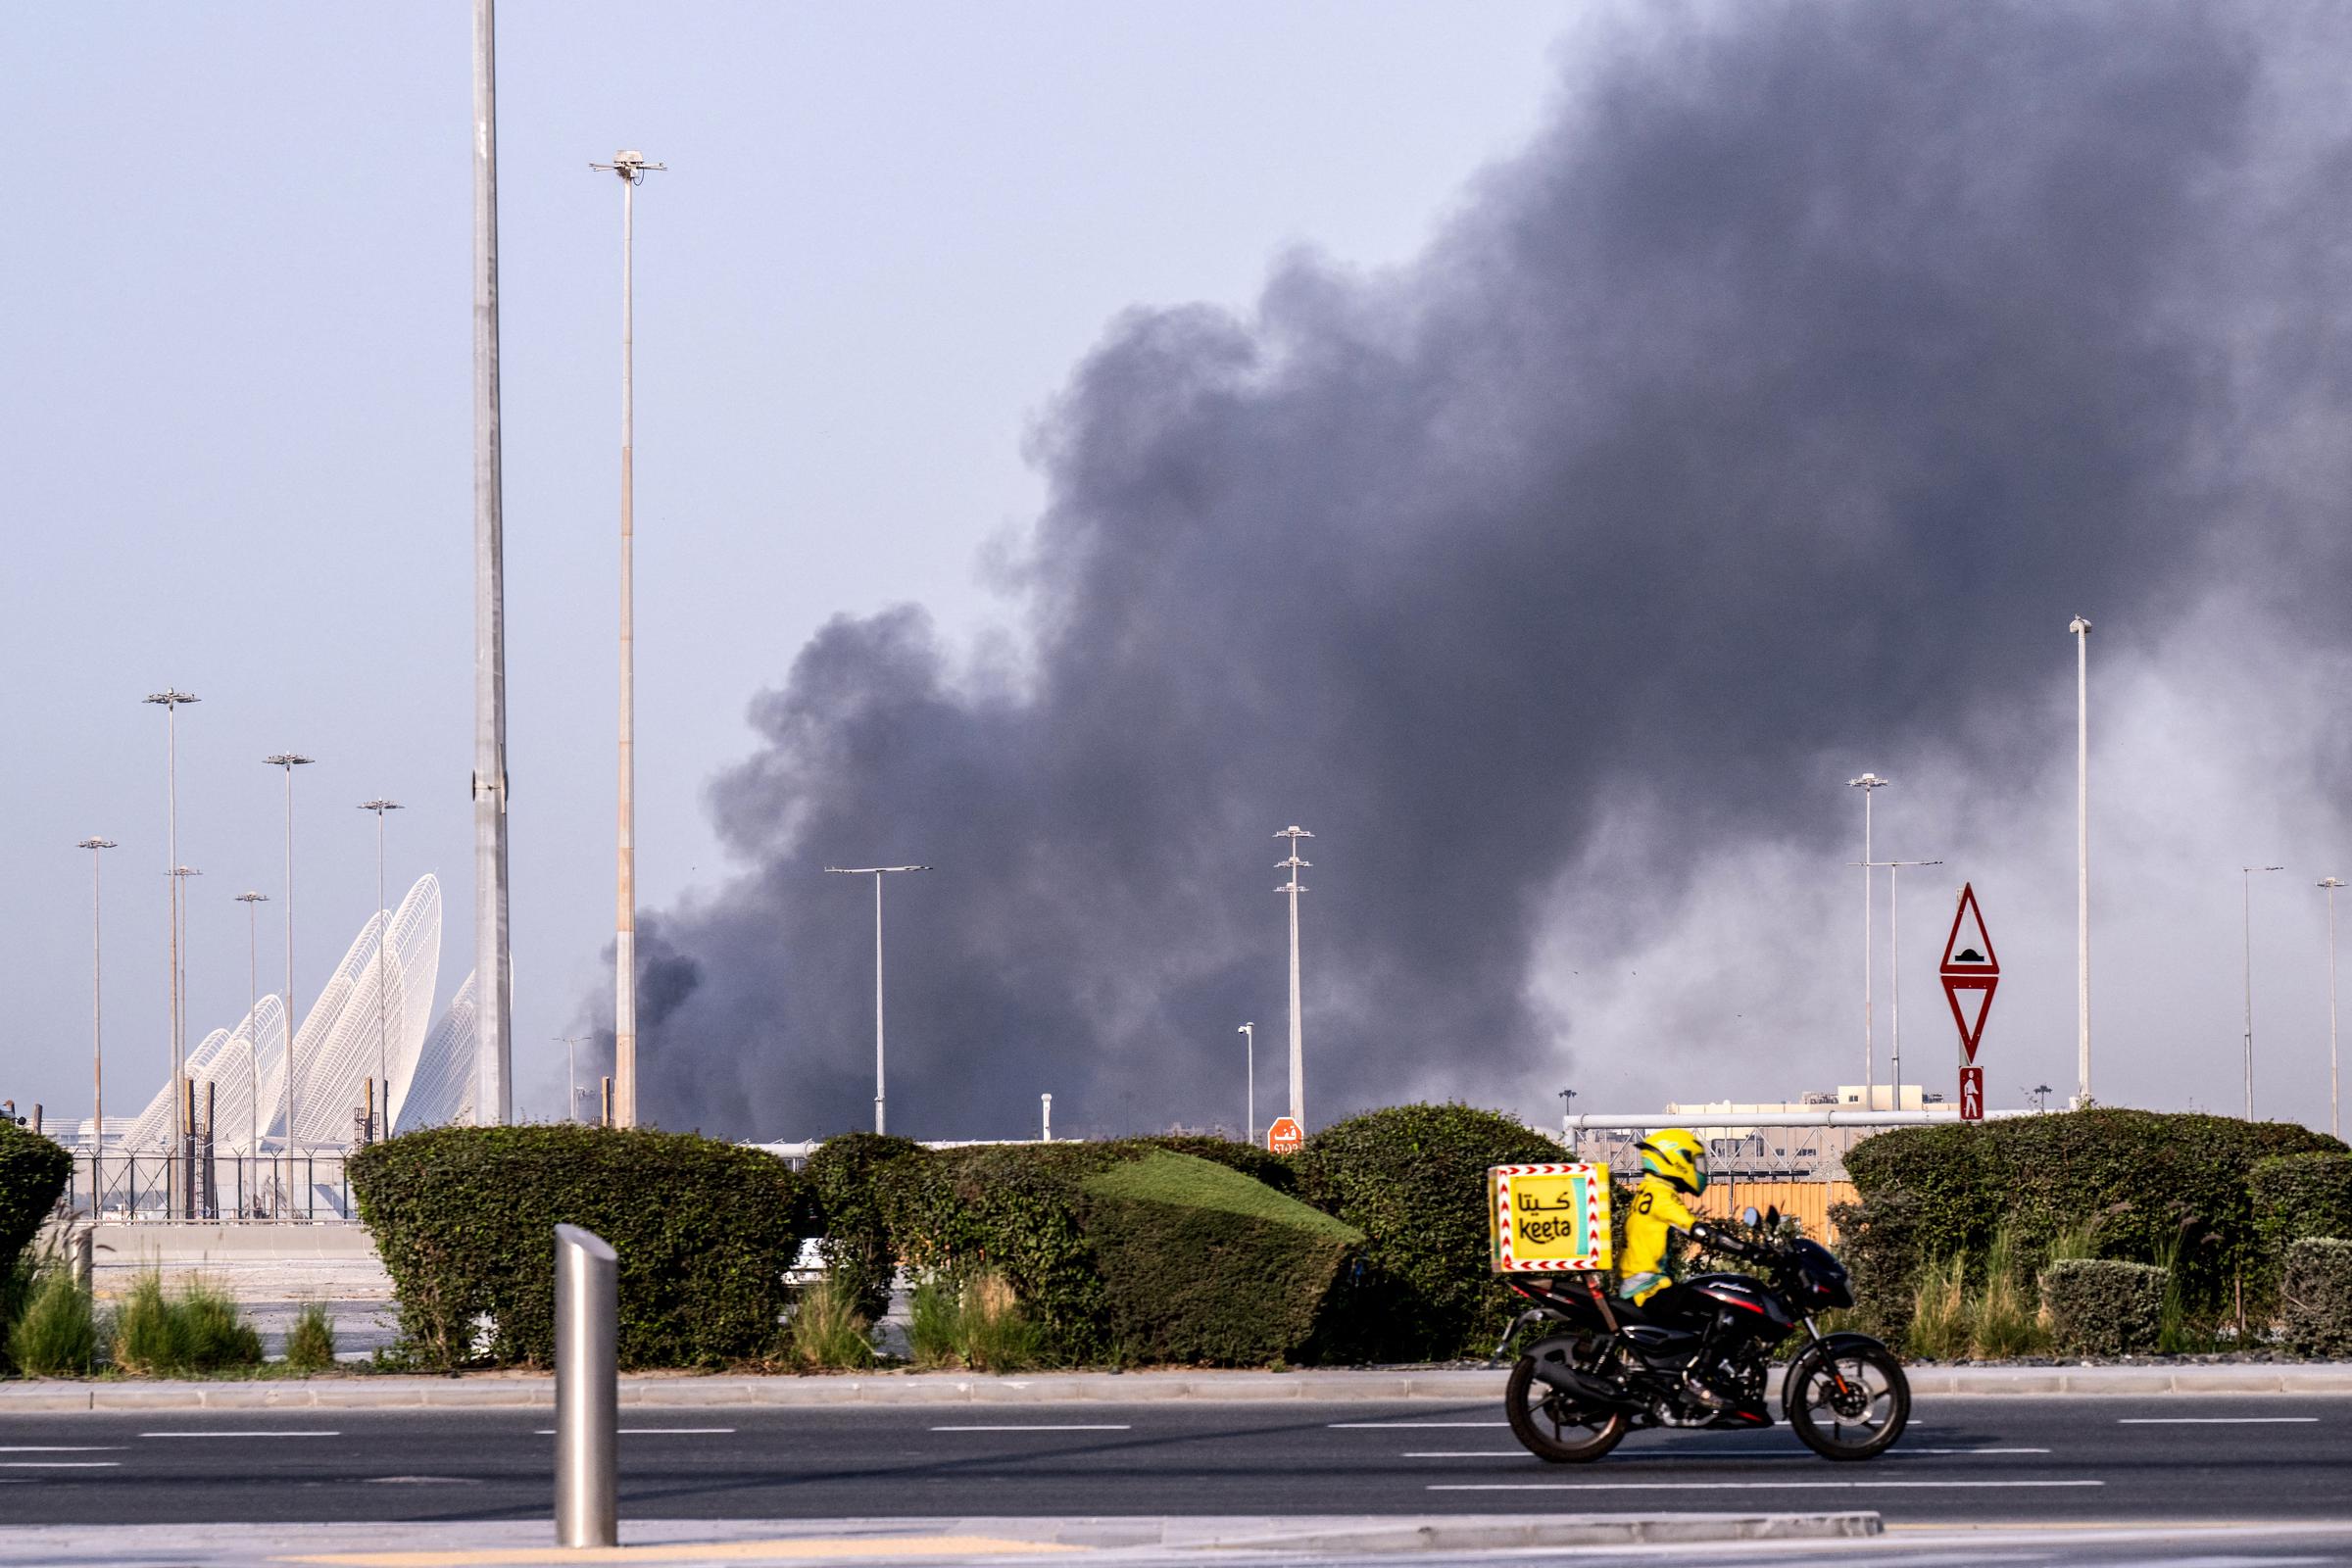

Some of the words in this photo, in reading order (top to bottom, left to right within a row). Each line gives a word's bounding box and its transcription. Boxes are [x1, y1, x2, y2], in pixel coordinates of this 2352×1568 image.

[1274, 1125, 1297, 1140] قف
[1274, 1143, 1298, 1154] STOP
[1518, 1191, 1570, 1216] كيتا
[1519, 1216, 1572, 1244] keeta
